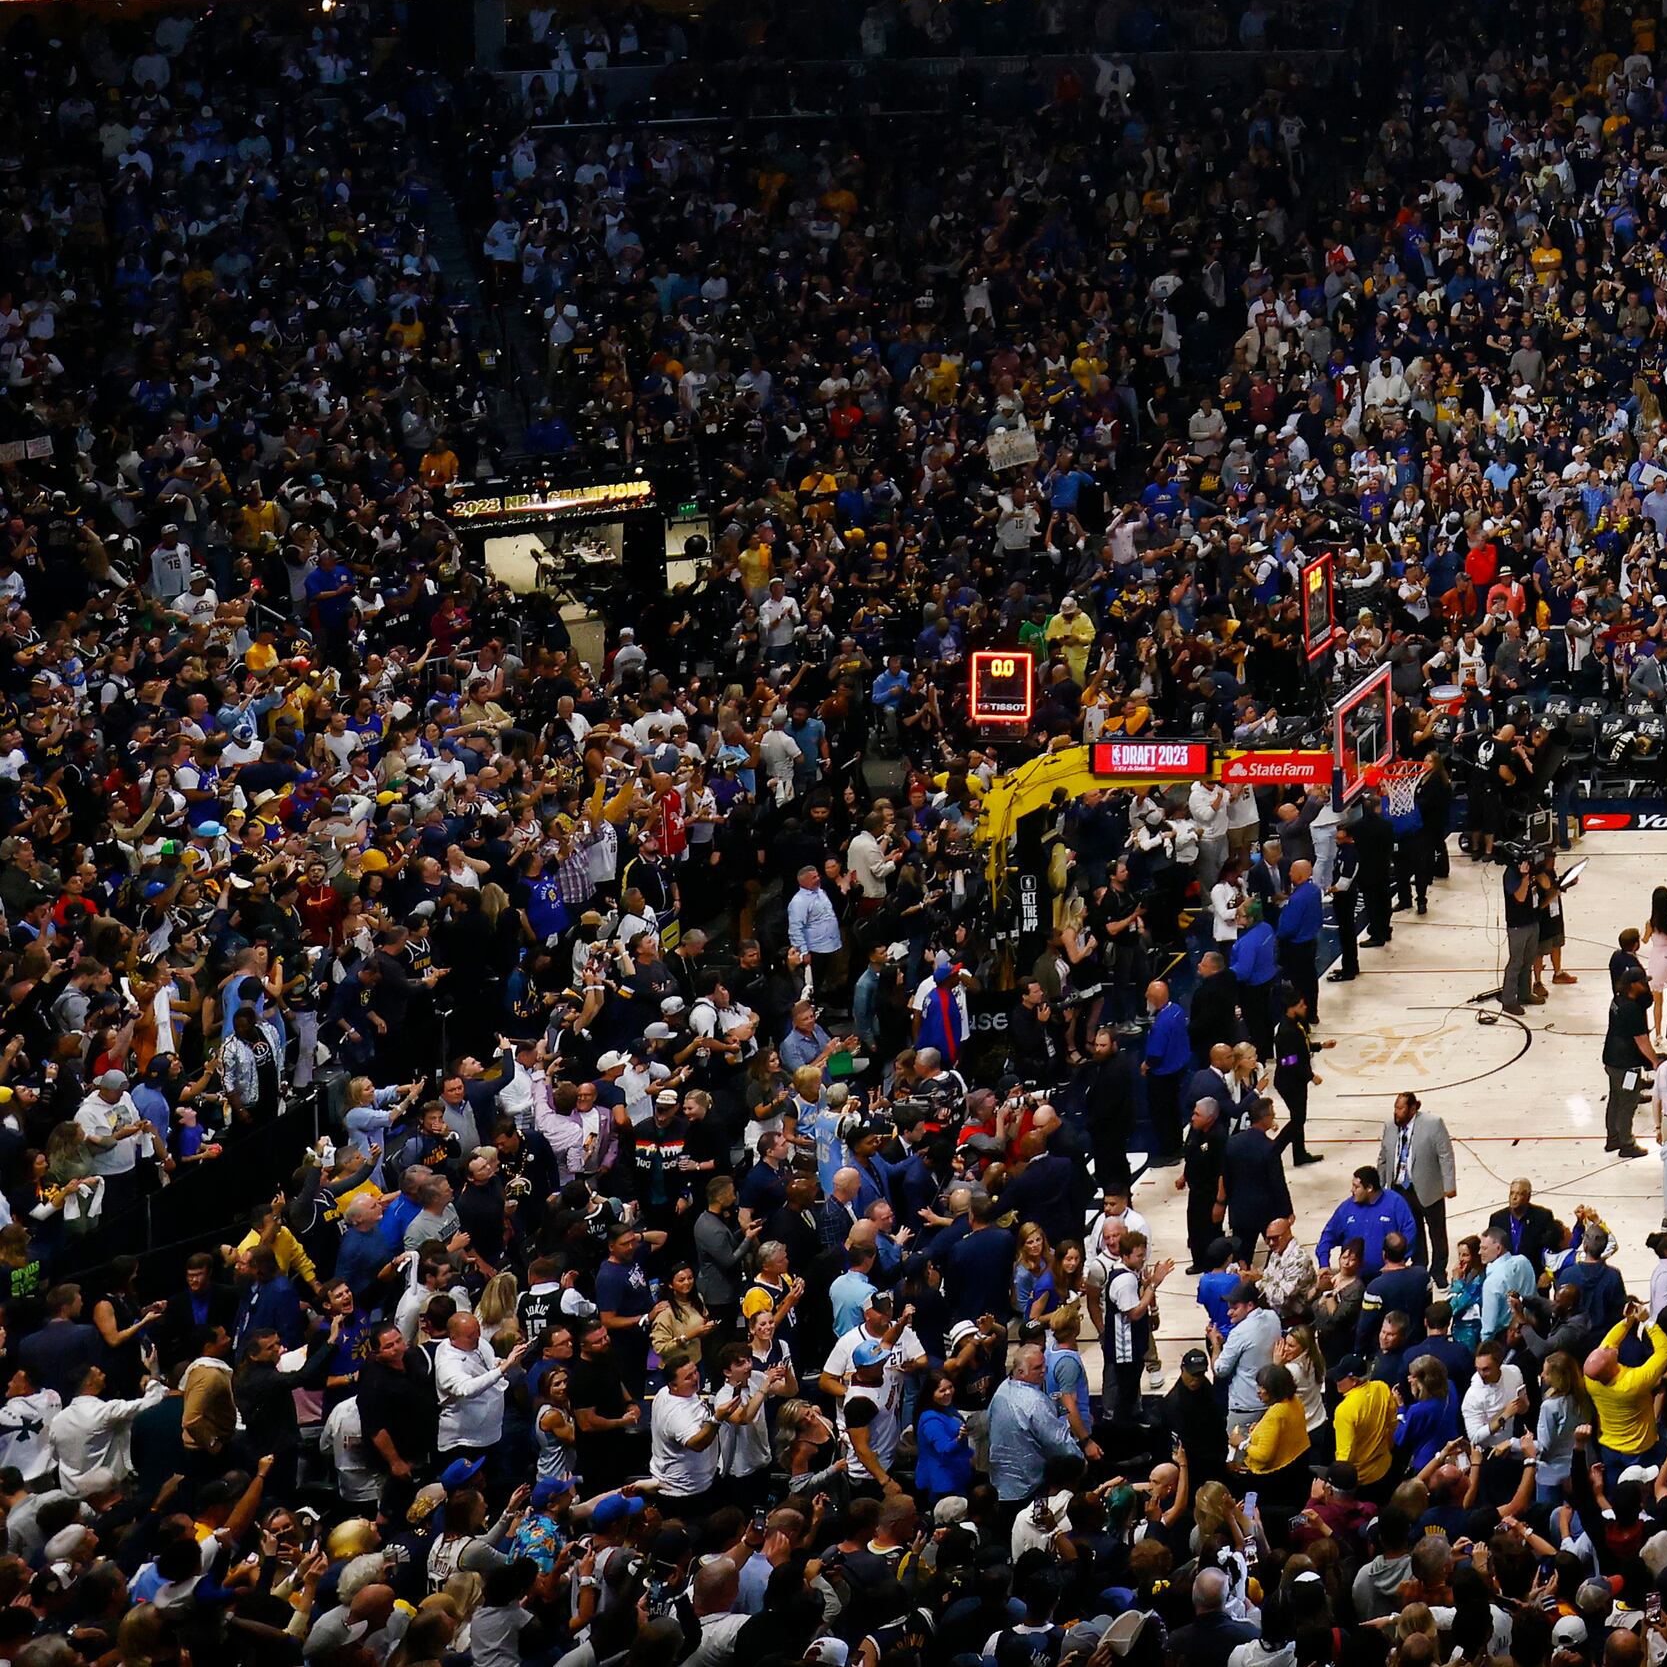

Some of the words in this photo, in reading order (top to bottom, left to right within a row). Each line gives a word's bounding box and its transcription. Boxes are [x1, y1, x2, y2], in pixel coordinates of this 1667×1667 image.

[452, 496, 501, 519] 2023
[504, 493, 542, 511] NBA
[546, 480, 651, 505] CHAMPIONS
[989, 701, 1027, 712] TISSOT
[1121, 744, 1156, 766] DRAFT
[1158, 745, 1190, 765] 2023
[1248, 761, 1314, 778] StateFarm
[1021, 892, 1038, 906] GET
[1022, 906, 1038, 920] THE
[1022, 920, 1039, 933] APP
[525, 1304, 549, 1318] JOKIC
